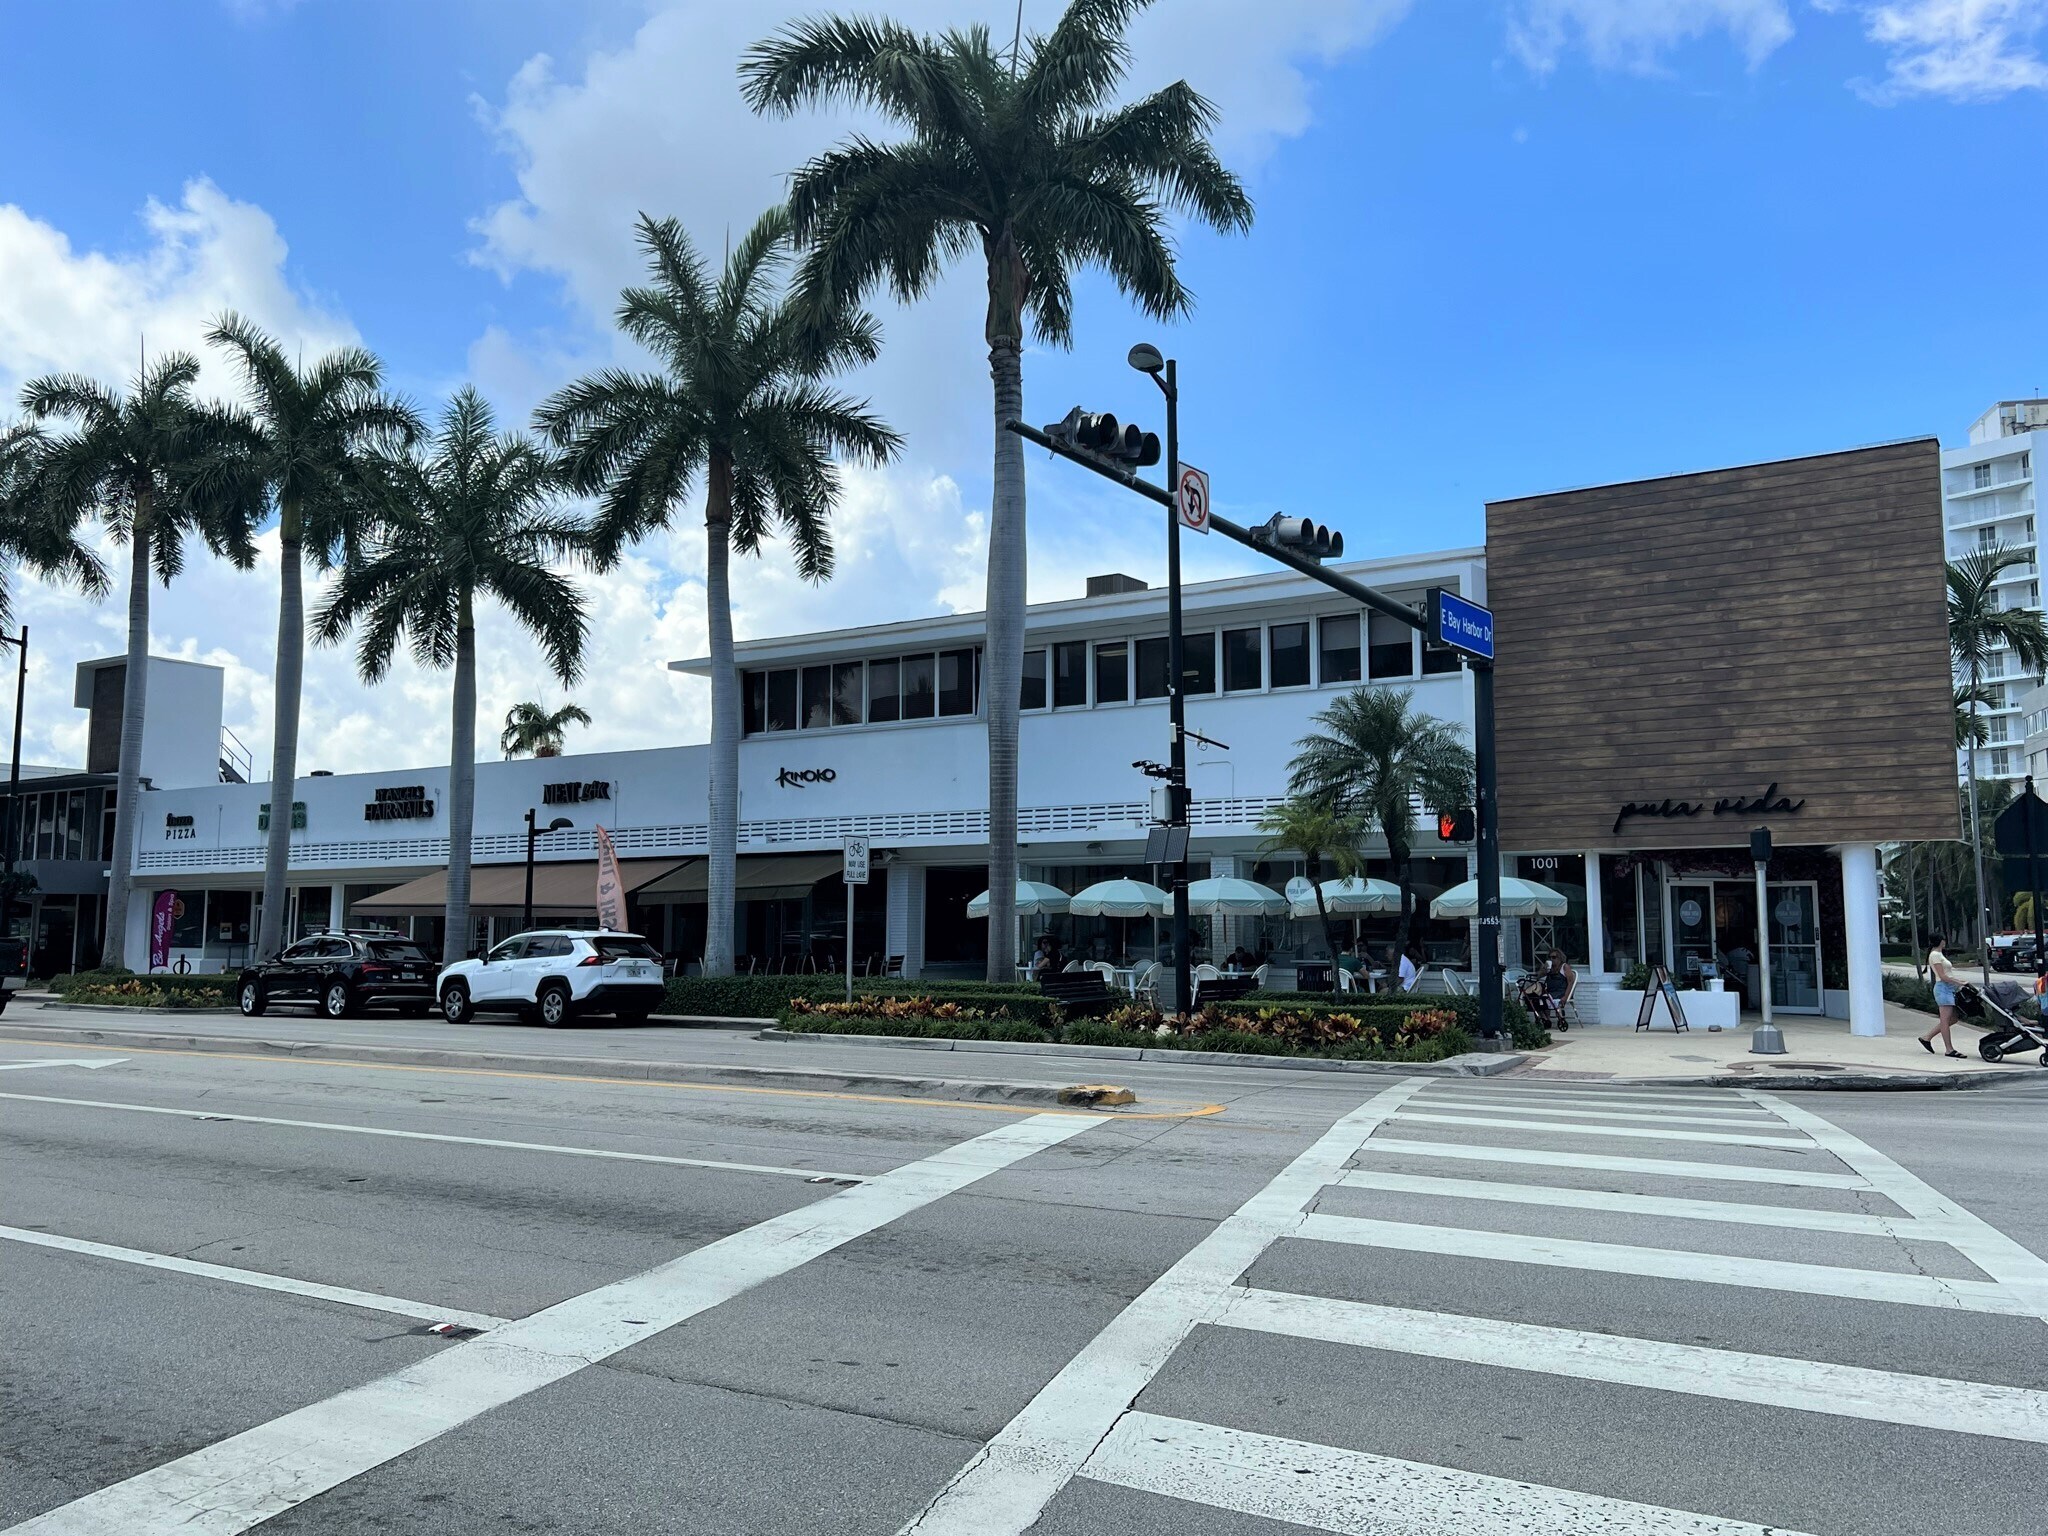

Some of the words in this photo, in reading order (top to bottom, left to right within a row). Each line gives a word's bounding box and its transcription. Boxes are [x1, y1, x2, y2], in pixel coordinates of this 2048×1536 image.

[1441, 608, 1447, 625] E
[1448, 611, 1461, 634] Bay
[1463, 617, 1483, 639] Harbor
[1484, 626, 1492, 643] Dr
[775, 767, 837, 788] KINOKO
[375, 788, 385, 801] BY
[542, 782, 581, 804] MEAT
[1713, 782, 1805, 815] vida
[165, 828, 196, 840] PIZZA
[848, 860, 856, 868] MAY
[857, 860, 866, 869] USE
[1531, 857, 1558, 869] 1001
[846, 870, 855, 878] FULL
[856, 870, 866, 879] LANE
[154, 911, 167, 947] Angels
